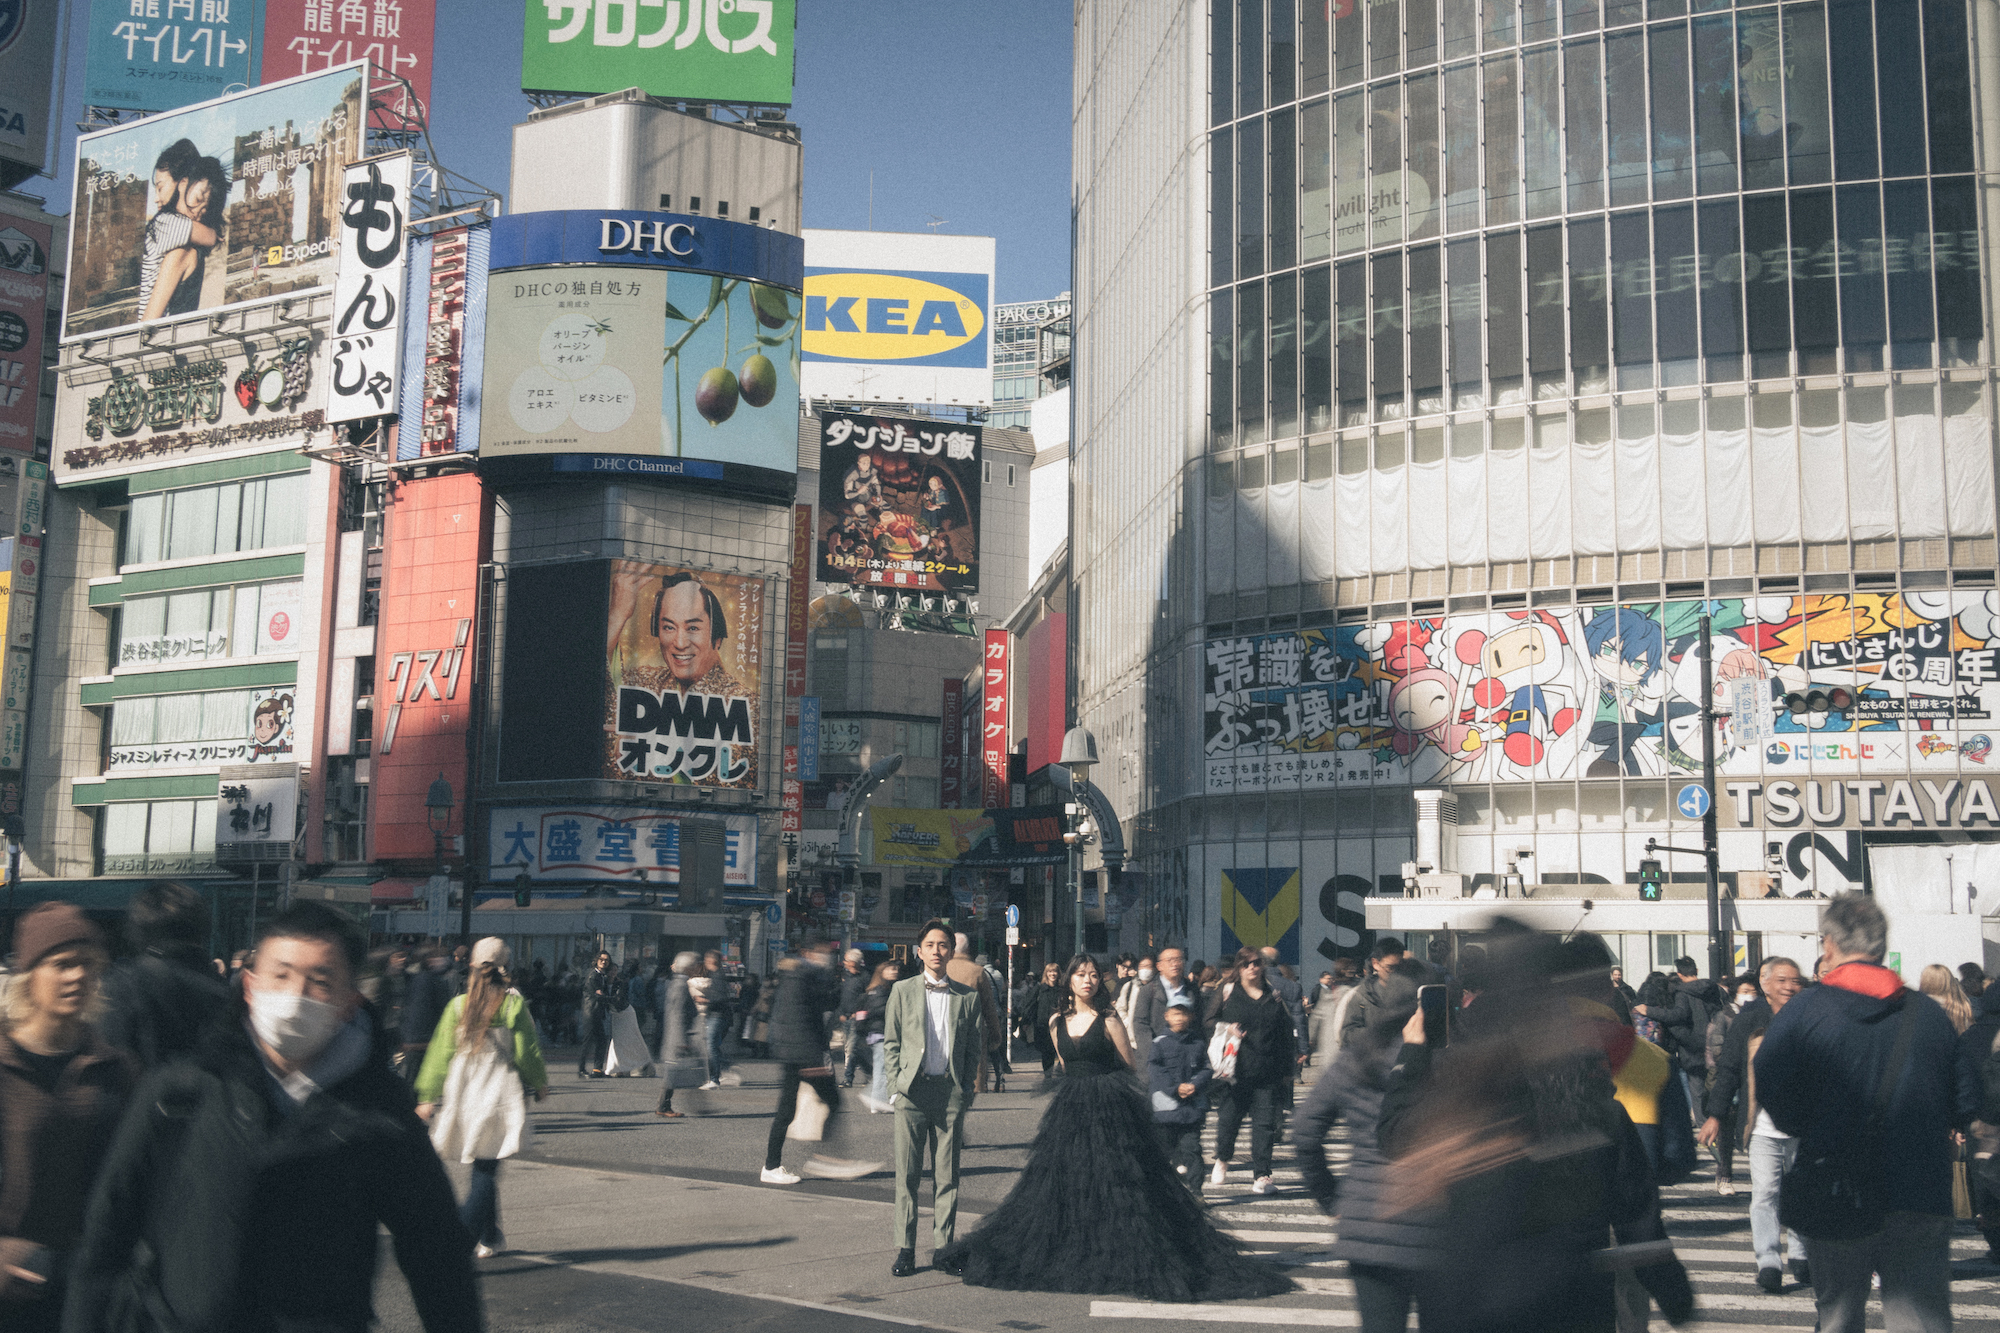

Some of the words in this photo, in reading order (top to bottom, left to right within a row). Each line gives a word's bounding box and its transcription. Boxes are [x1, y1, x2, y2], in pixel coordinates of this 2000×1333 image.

[303, 0, 402, 38] 龍角散
[543, 0, 777, 56] サロンパス
[112, 22, 247, 68] ダイレクト
[242, 136, 347, 178] 時間は限られて
[1325, 188, 1400, 221] Twilight
[598, 218, 695, 256] DHC
[333, 163, 401, 409] もんじゃ
[514, 281, 641, 299] DHCの独自処方
[804, 295, 968, 338] KEA
[997, 304, 1050, 324] PARCO
[553, 329, 591, 339] オリーブ
[553, 342, 591, 351] バージン
[557, 354, 585, 364] オイル
[527, 388, 554, 398] アロエ
[527, 400, 554, 410] エキス
[579, 393, 622, 404] ビタミンE
[826, 418, 977, 461] ダンジョン飯
[593, 458, 625, 472] DHC
[628, 459, 684, 474] Channel
[870, 571, 927, 586] 放送開始!!
[750, 583, 761, 664] クレーンゲームは
[1811, 622, 1943, 666] にじさんじ
[1206, 635, 1342, 697] 常識を
[1888, 649, 1998, 686] 6周年
[380, 618, 471, 754] クスリ
[984, 642, 1005, 739] カラオケ
[617, 686, 753, 744] DMM
[1917, 711, 1951, 719] RENEWAL
[111, 748, 197, 766] ジャスミンレディース
[200, 744, 246, 762] クリニック
[619, 739, 750, 782] オンクレ
[1795, 743, 1874, 761] にじさんじ
[1726, 779, 1999, 823] TSUTAYA
[725, 872, 748, 881] AISEIDO
